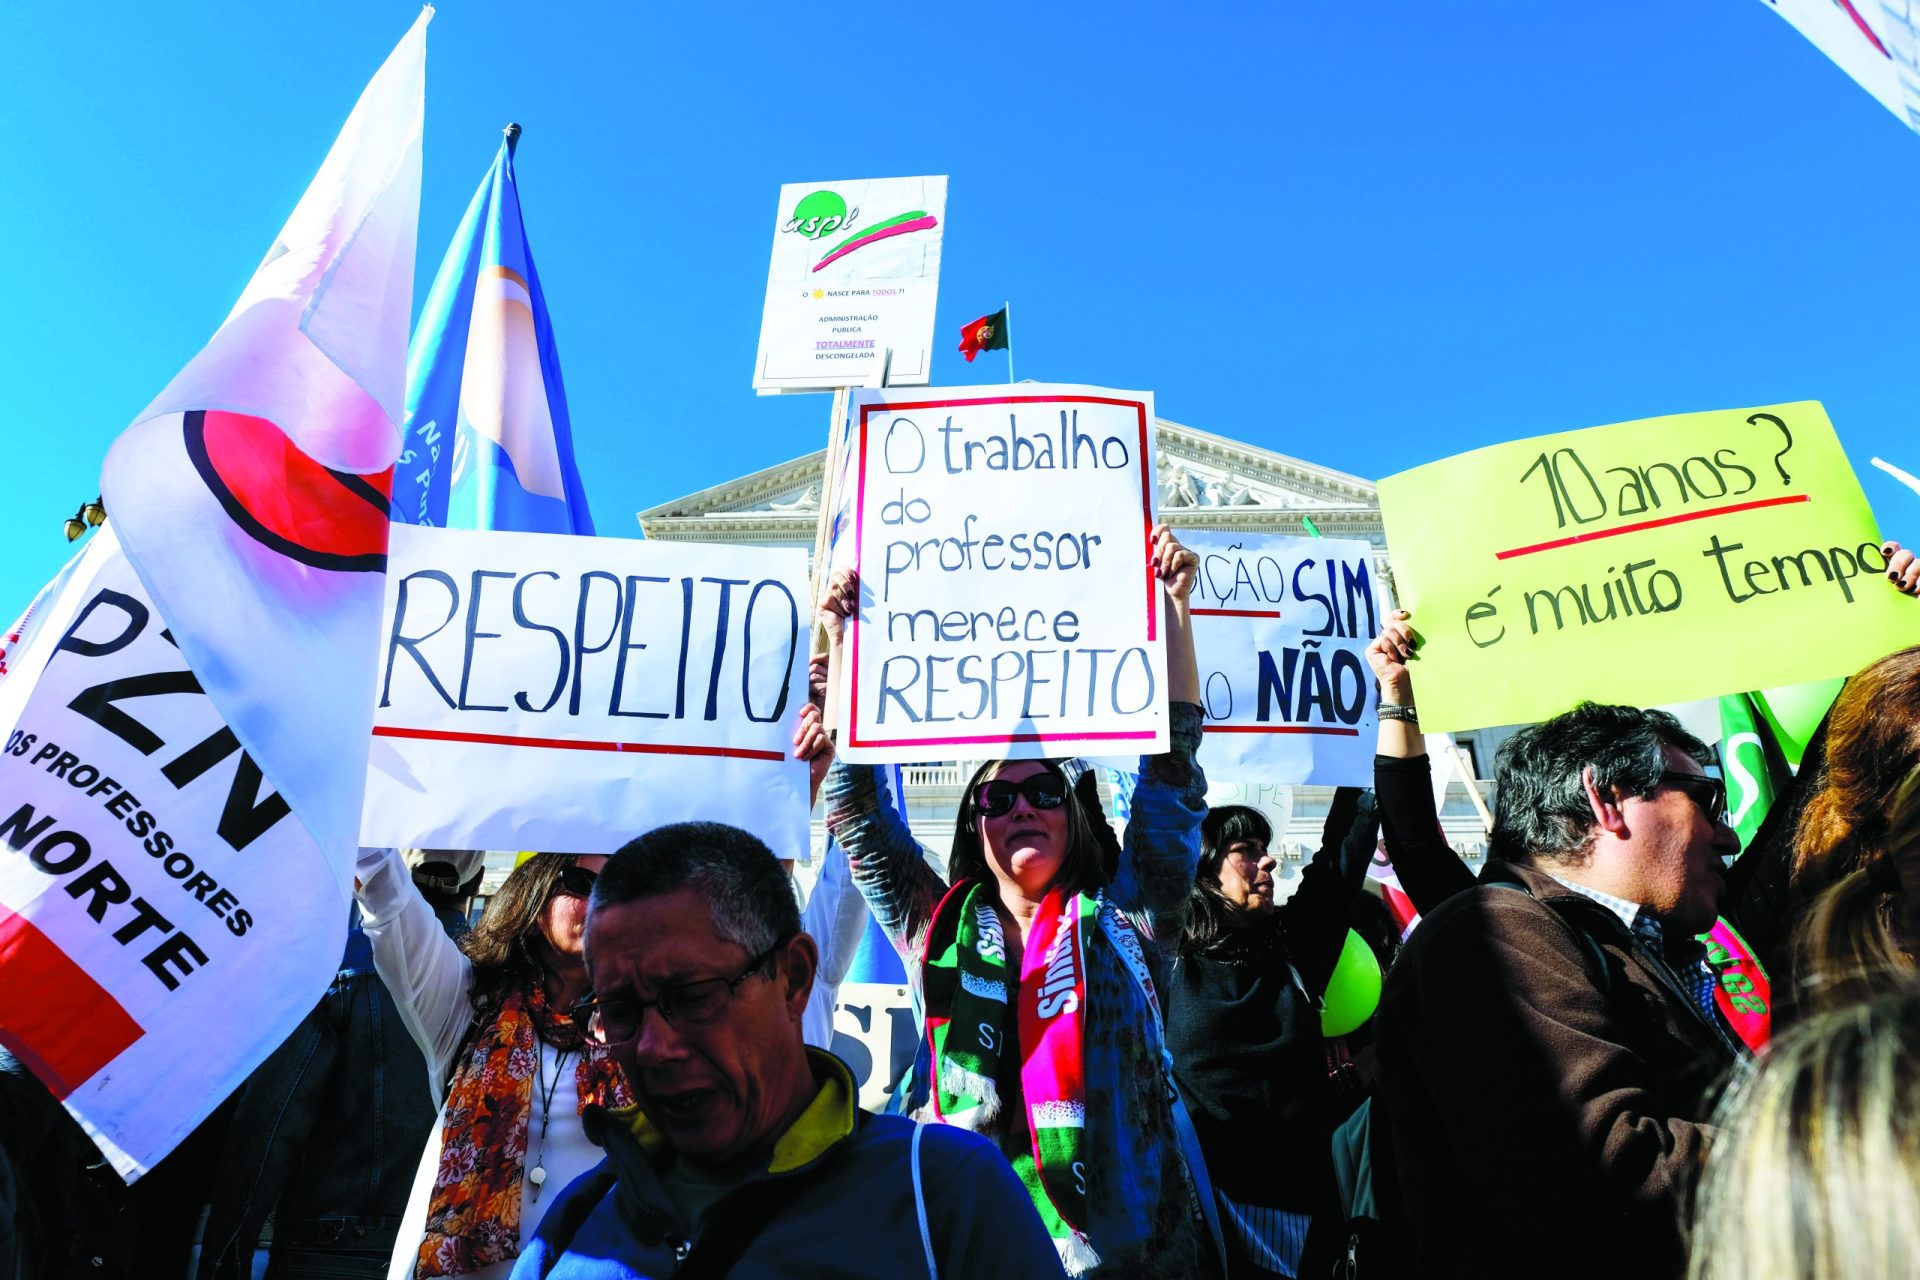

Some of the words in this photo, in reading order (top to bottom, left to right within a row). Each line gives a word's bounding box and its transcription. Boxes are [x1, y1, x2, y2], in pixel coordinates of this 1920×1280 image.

[818, 313, 879, 323] ADMINISTRAÇÃO
[872, 288, 897, 296] TODOS
[815, 339, 875, 350] TOTALMENTE
[815, 352, 875, 360] DESCONGELADA
[884, 417, 926, 474] O
[938, 409, 1130, 474] trabalho
[881, 487, 931, 526] do
[884, 514, 1102, 602] professor
[1464, 585, 1506, 648] é
[1523, 558, 1683, 636] muito
[1702, 535, 1890, 603] tempo
[887, 606, 1081, 643] merece
[1292, 558, 1377, 639] SIM
[379, 569, 799, 723] RESPEITO
[876, 647, 1159, 724] RESPEITO.
[30, 742, 254, 938] PROFESSORES
[0, 802, 210, 992] NORTE
